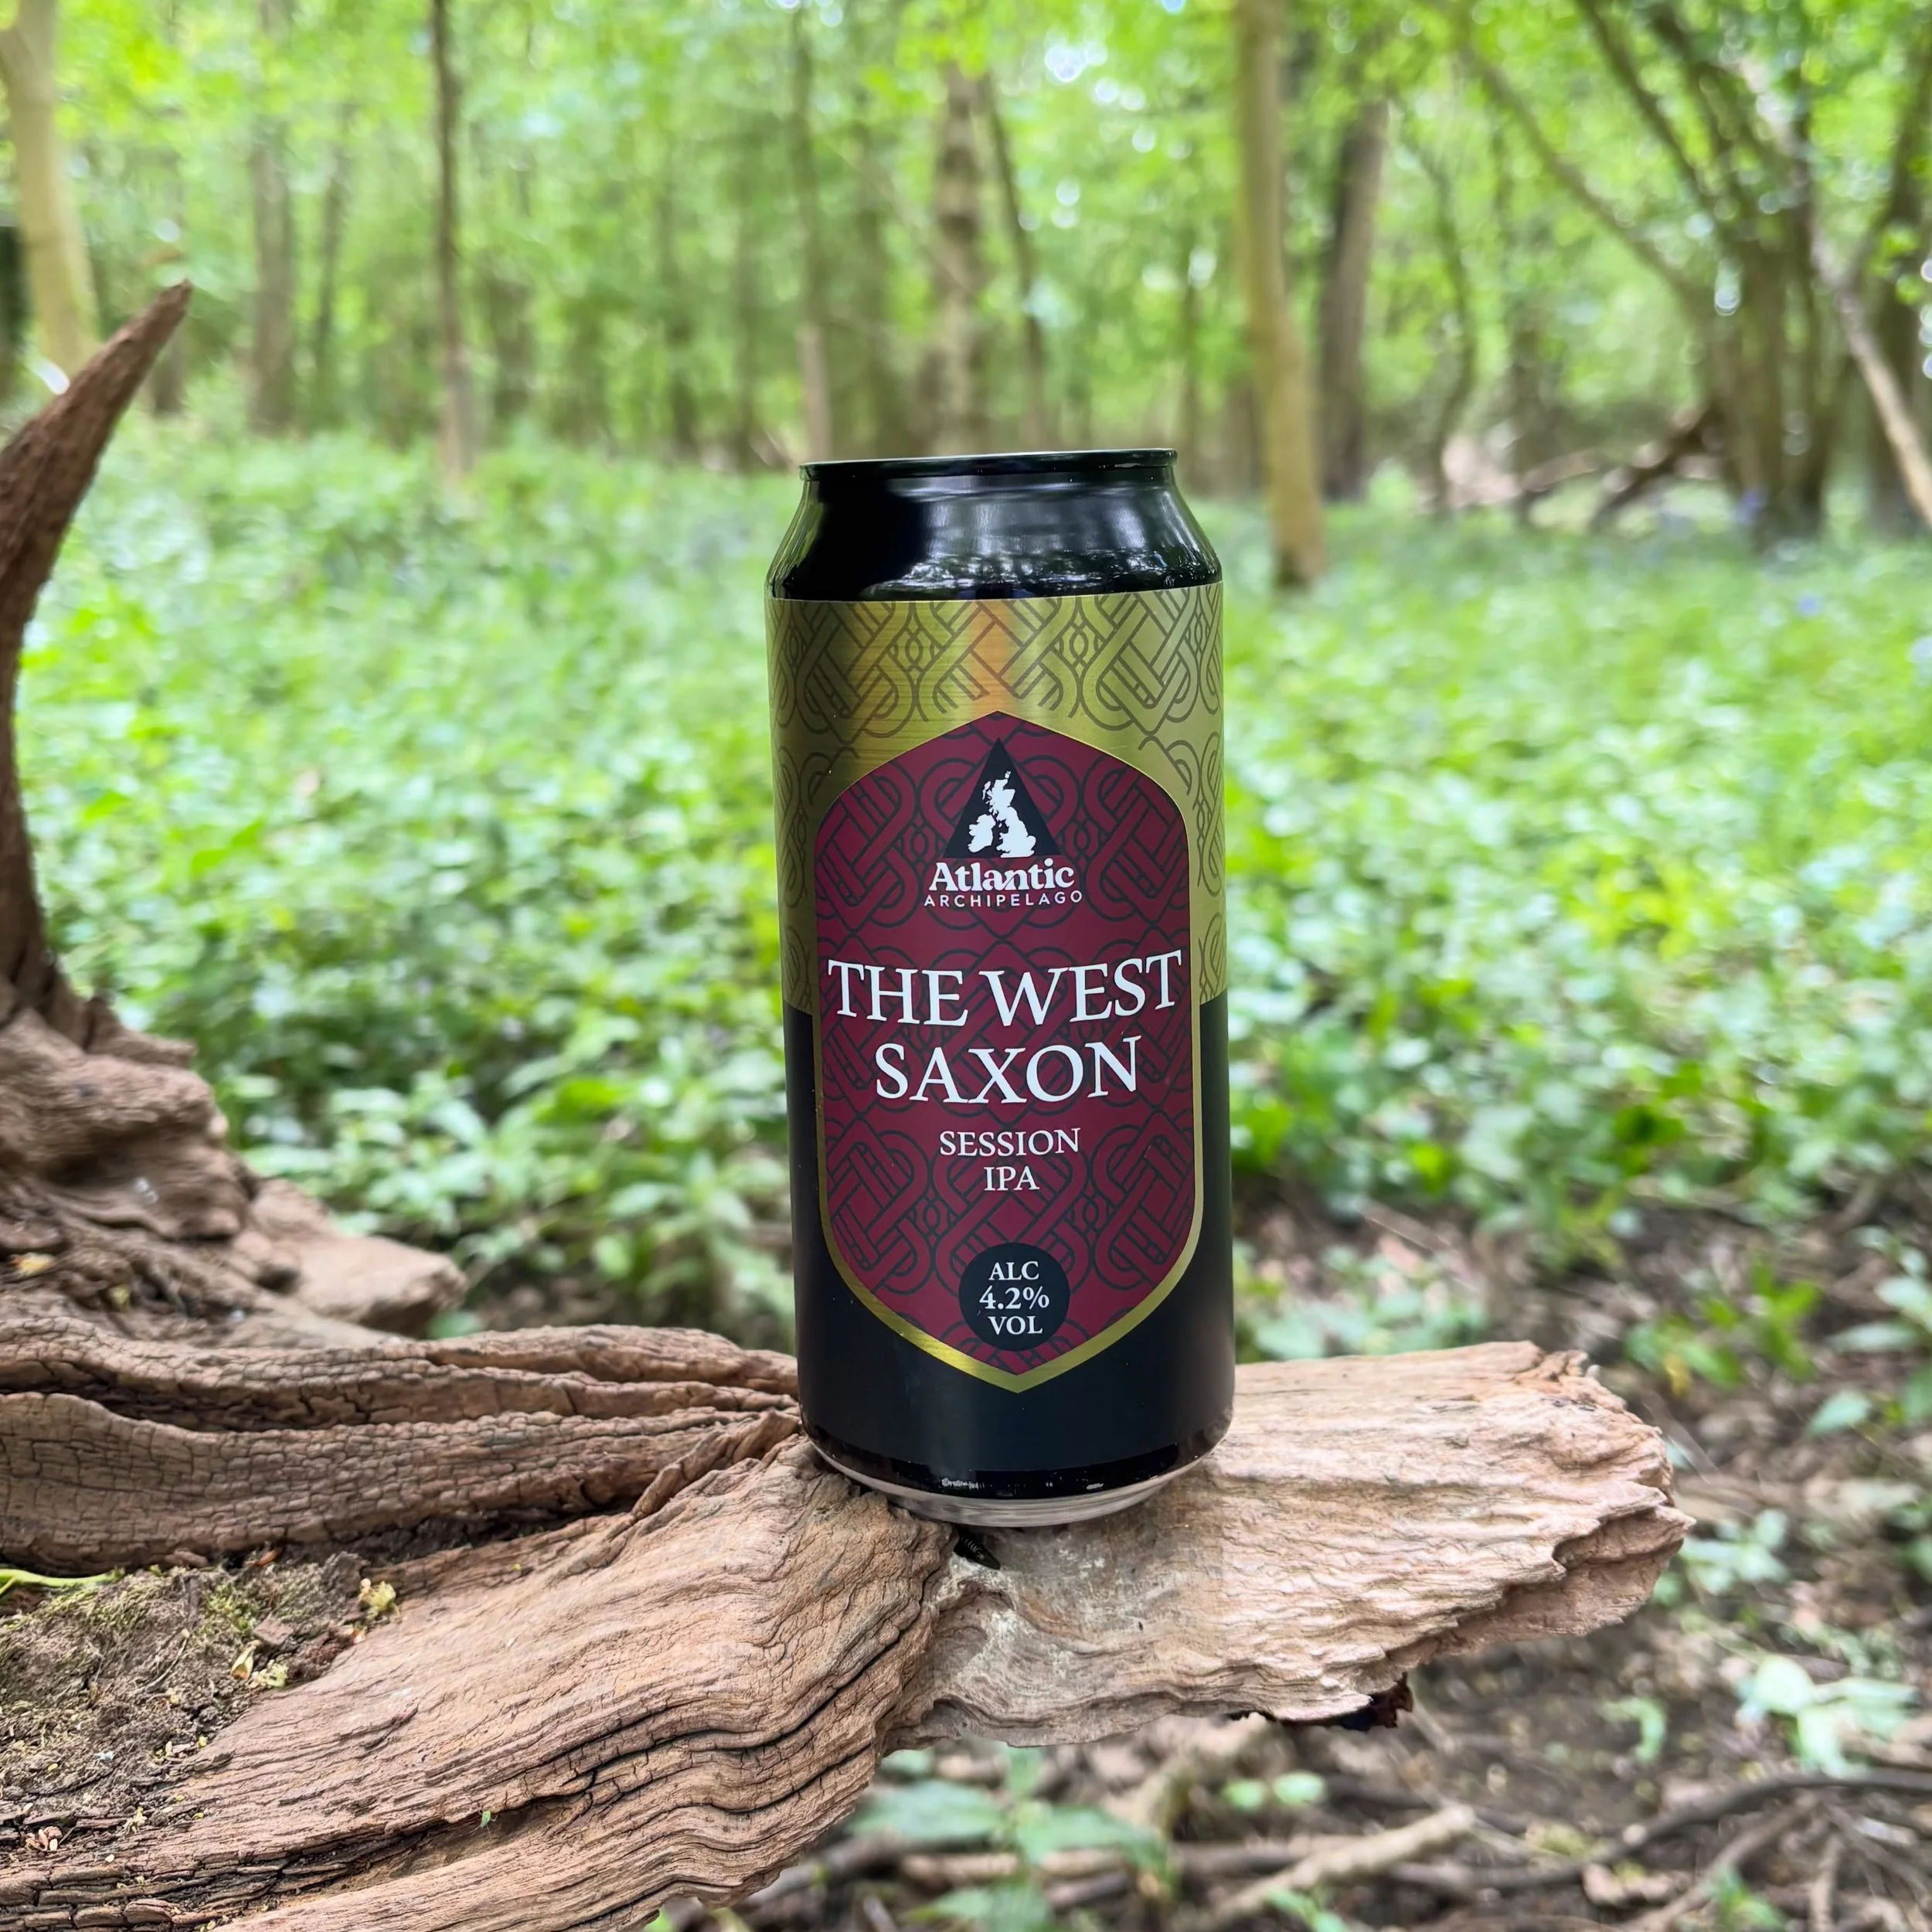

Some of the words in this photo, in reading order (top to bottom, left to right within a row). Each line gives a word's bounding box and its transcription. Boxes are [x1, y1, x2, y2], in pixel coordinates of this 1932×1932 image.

[928, 858, 1075, 892] Atlantic
[923, 890, 1082, 907] ARCHIPELAGO
[828, 960, 968, 1027] THE
[978, 950, 1182, 1027] WEST
[875, 1036, 1141, 1104] SAXON
[939, 1128, 1080, 1157] SESSION
[983, 1165, 1040, 1191] IPA
[988, 1260, 1039, 1281] ALC
[978, 1284, 1049, 1310] 4.2%
[988, 1315, 1043, 1335] VOL
